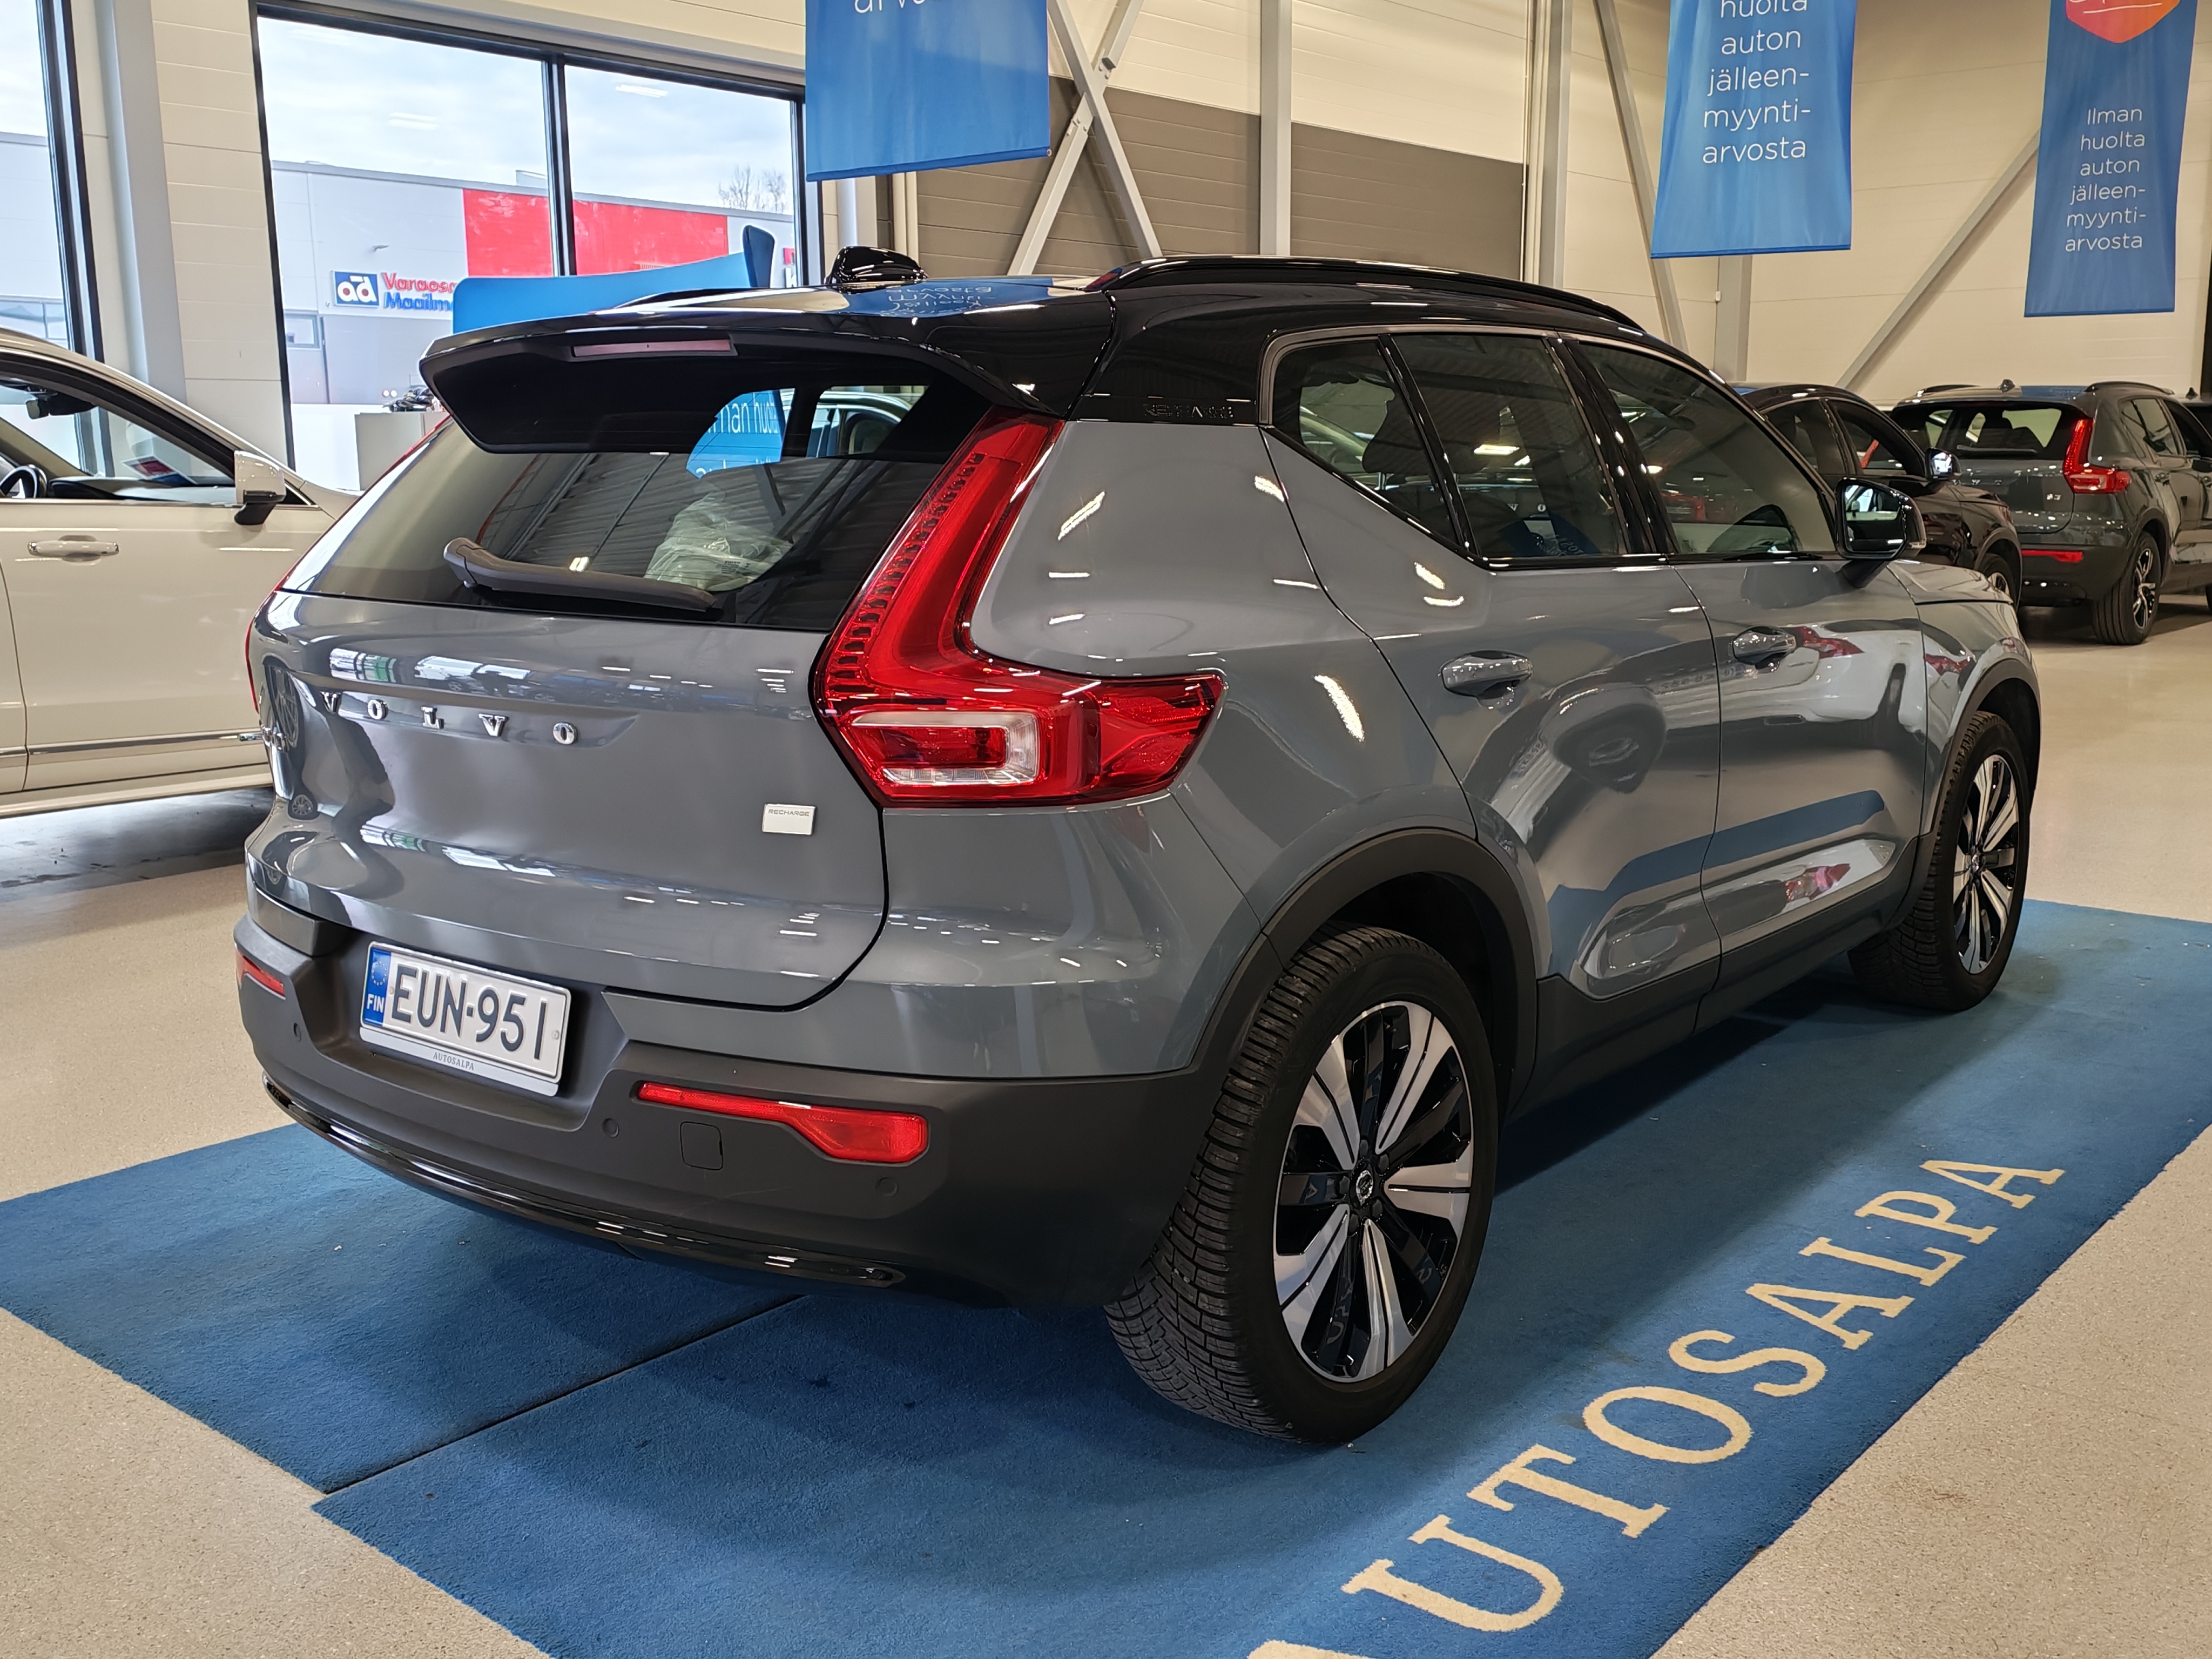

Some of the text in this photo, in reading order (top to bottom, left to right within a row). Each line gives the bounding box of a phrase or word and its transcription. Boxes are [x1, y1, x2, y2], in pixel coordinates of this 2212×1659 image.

[1721, 0, 1807, 18] huolta
[1721, 30, 1801, 55] auton
[1707, 66, 1809, 97] jälleen-
[1704, 98, 1811, 131] myynti-
[2087, 109, 2142, 125] Ilman
[1703, 137, 1806, 164] arvosta
[2080, 131, 2146, 151] huolta
[2080, 159, 2140, 176] auton
[2070, 184, 2146, 205] jälleen-
[2067, 207, 2147, 229] myynti-
[2065, 232, 2143, 252] arvosta
[383, 292, 454, 312] Maailm
[708, 403, 751, 434] man
[319, 690, 578, 745] VOLVO
[366, 963, 547, 1061] FIN EUN-951
[433, 1051, 475, 1071] AUTOSALPA
[1246, 1159, 2066, 1659] UTOSALPA
